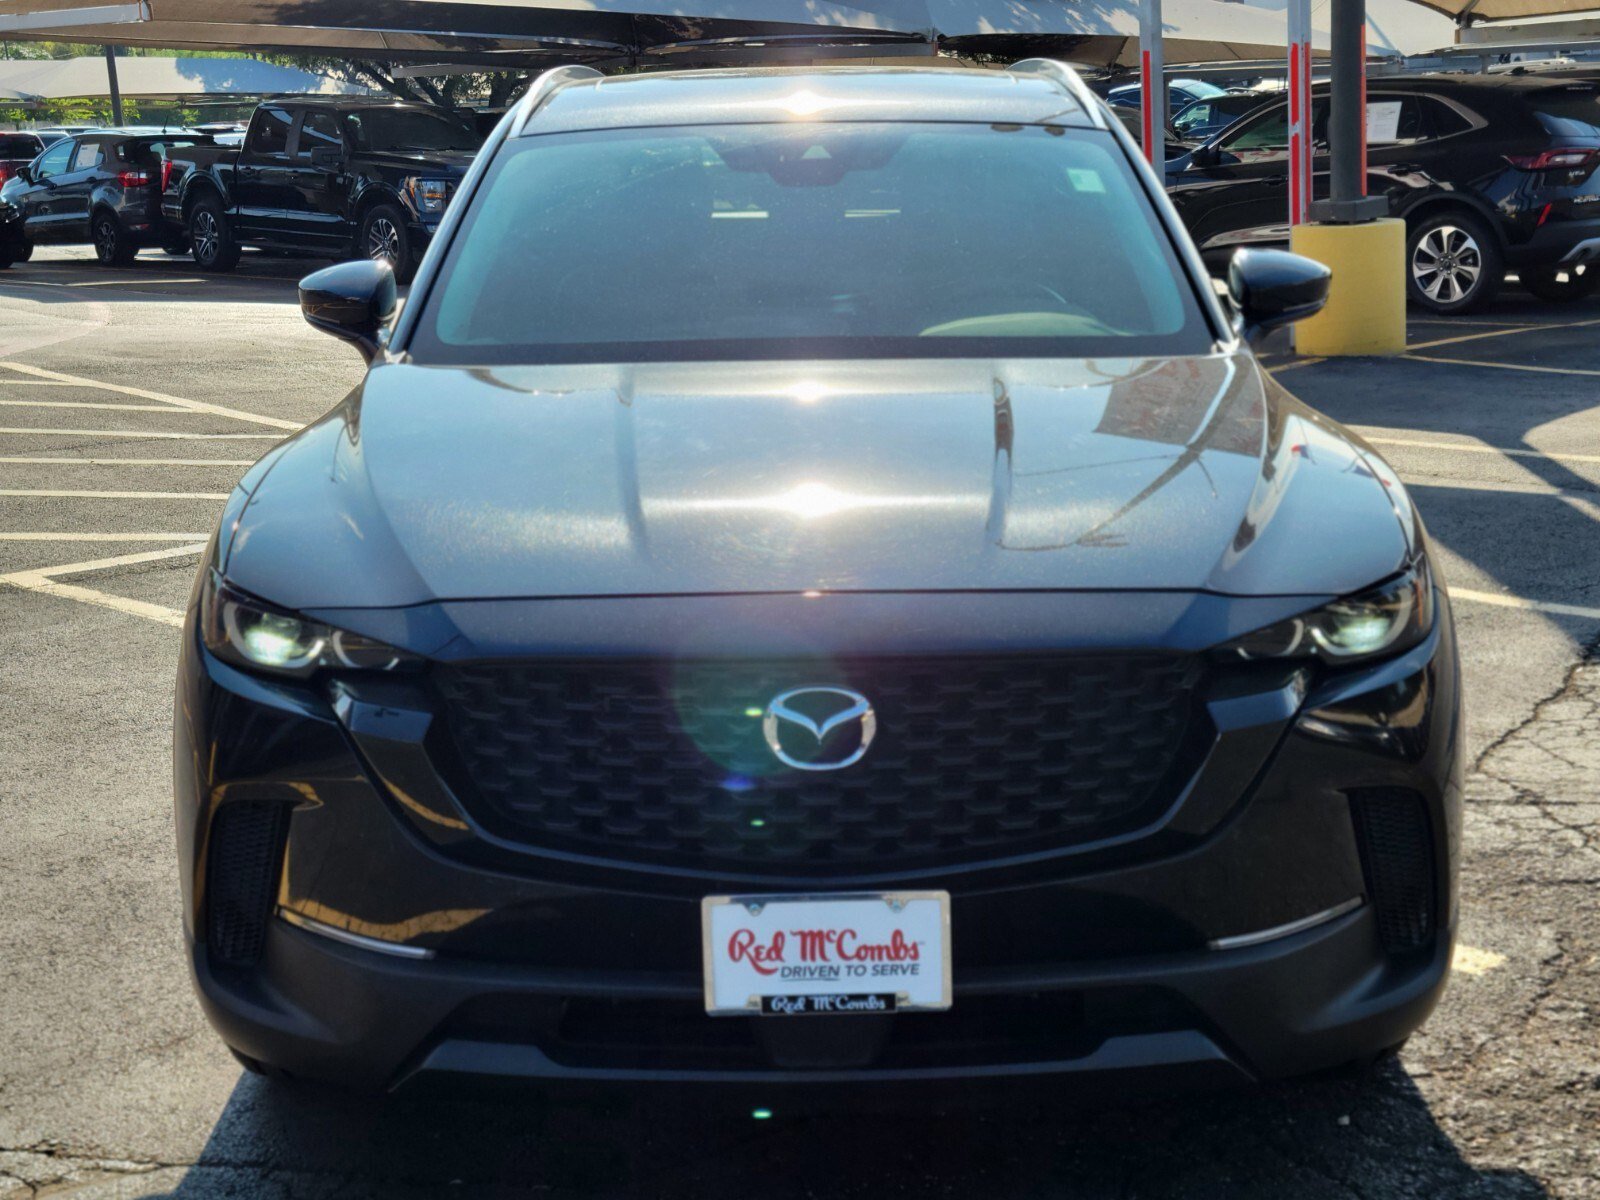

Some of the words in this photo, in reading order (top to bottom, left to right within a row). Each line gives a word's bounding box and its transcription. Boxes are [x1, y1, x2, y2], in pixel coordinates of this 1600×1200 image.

[728, 928, 786, 976] Red
[790, 928, 920, 962] McCombs
[780, 965, 840, 979] DRIVEN
[845, 964, 868, 977] TO
[871, 963, 921, 976] SERVE
[770, 996, 806, 1014] Red
[809, 994, 886, 1011] McCombs
